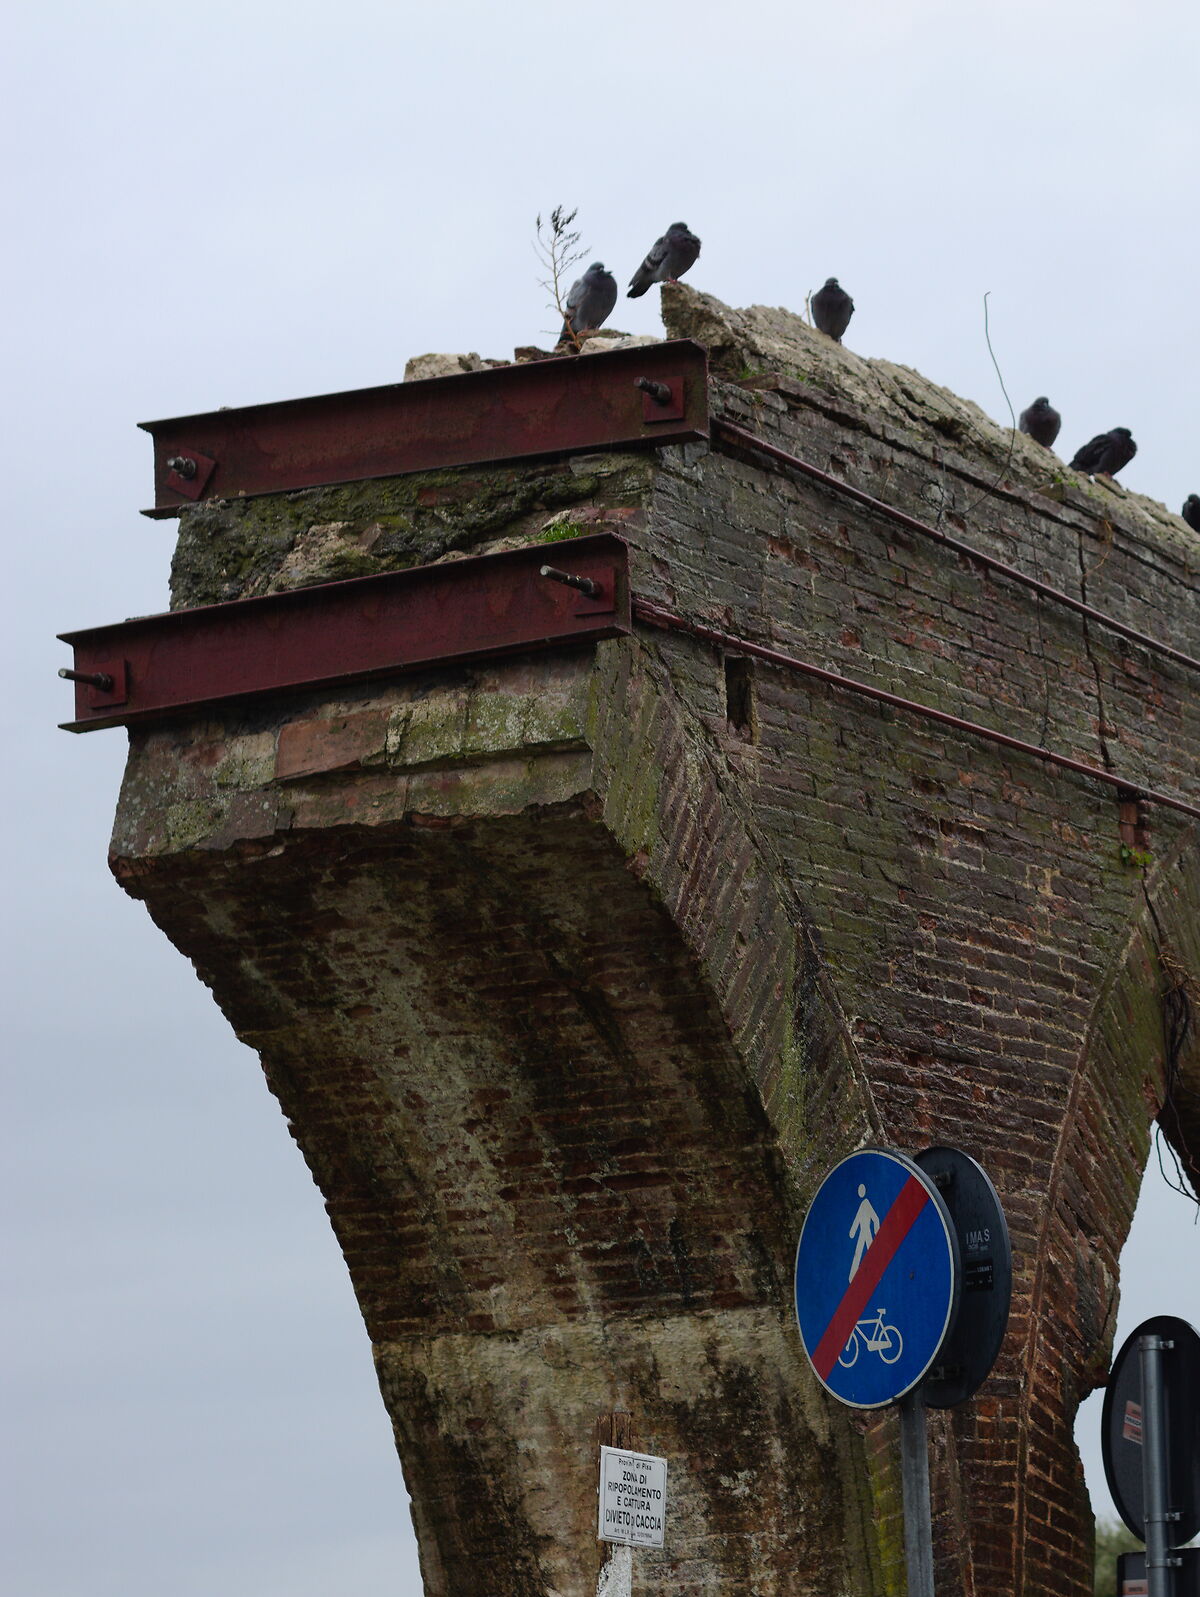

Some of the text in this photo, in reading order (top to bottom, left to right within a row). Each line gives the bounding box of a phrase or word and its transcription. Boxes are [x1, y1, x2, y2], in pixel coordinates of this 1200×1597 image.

[642, 1463, 652, 1471] Pisa
[623, 1471, 646, 1484] ZONA DI
[608, 1482, 661, 1499] RIPOPOLAMENTO
[617, 1496, 650, 1511] E CATTURA
[606, 1509, 630, 1525] DIVIETO
[636, 1515, 661, 1530] CACCIA
